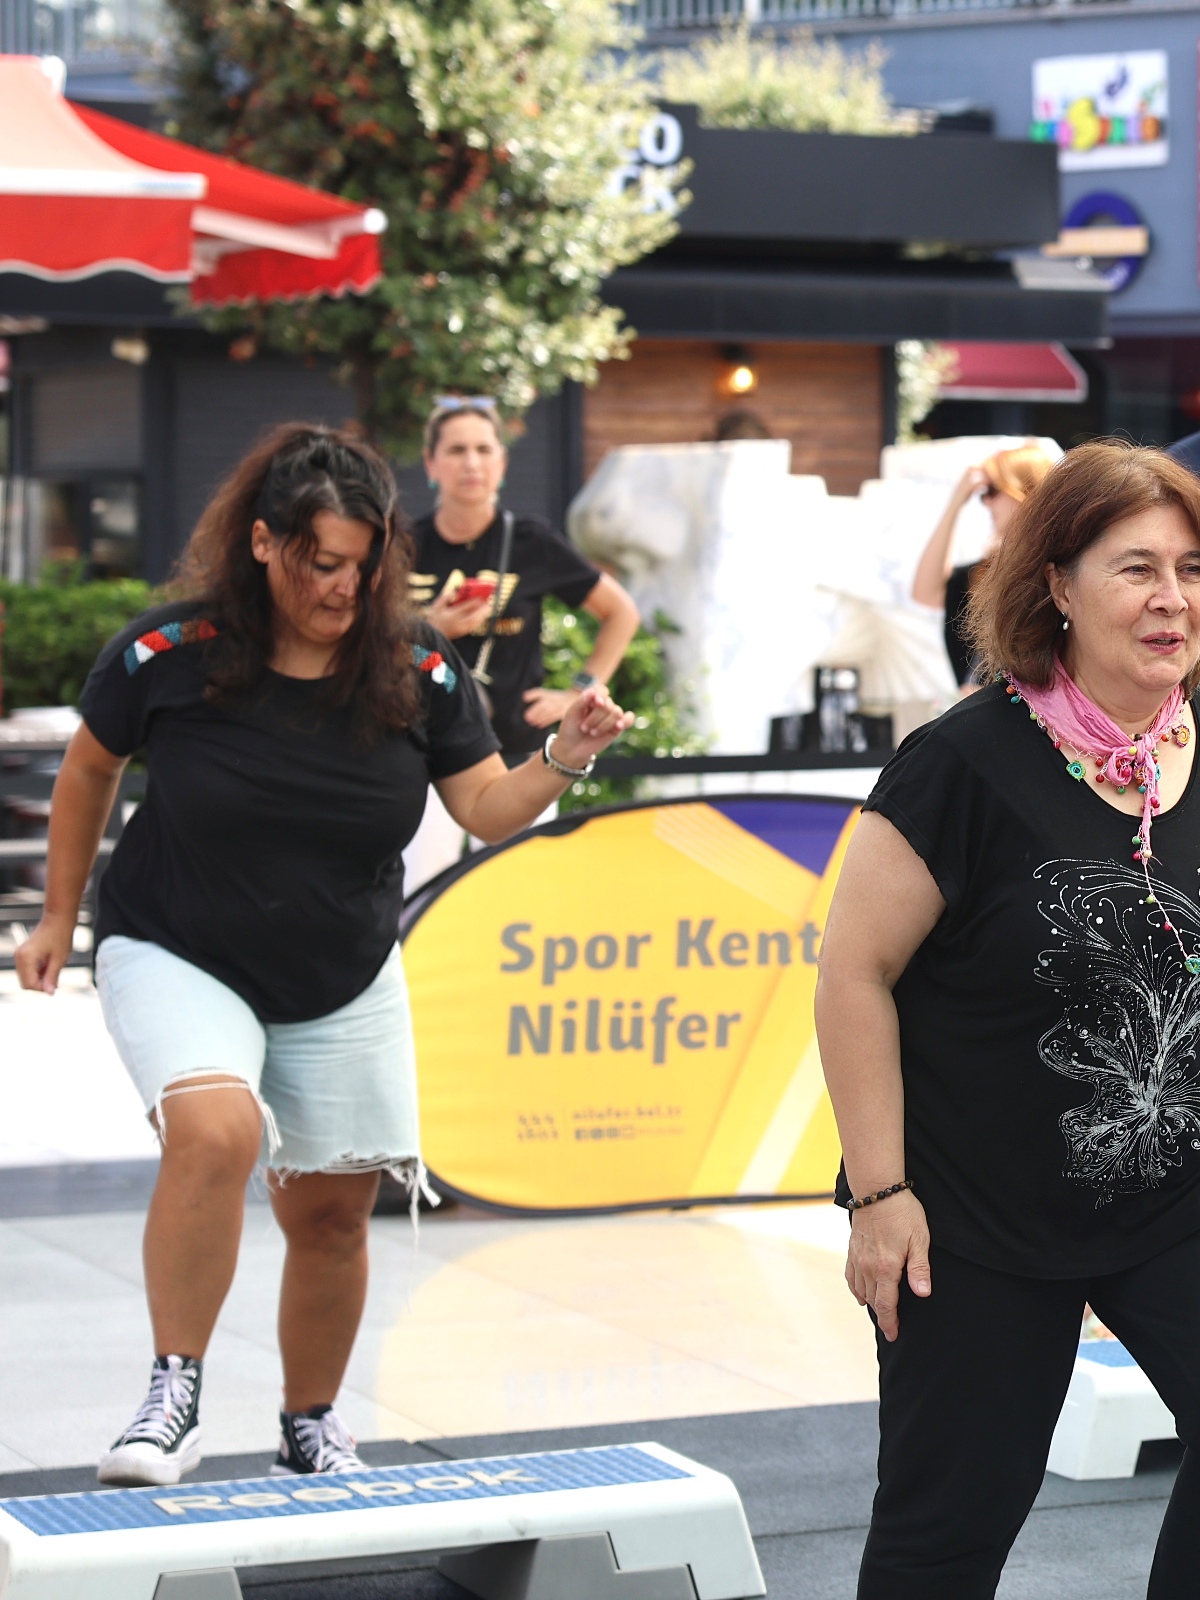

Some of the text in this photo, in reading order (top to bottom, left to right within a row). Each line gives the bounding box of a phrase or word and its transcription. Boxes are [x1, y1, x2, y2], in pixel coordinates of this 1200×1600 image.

[500, 917, 822, 987] Spor Kent
[507, 995, 742, 1065] Nilüfer
[152, 1467, 547, 1517] Reebok
